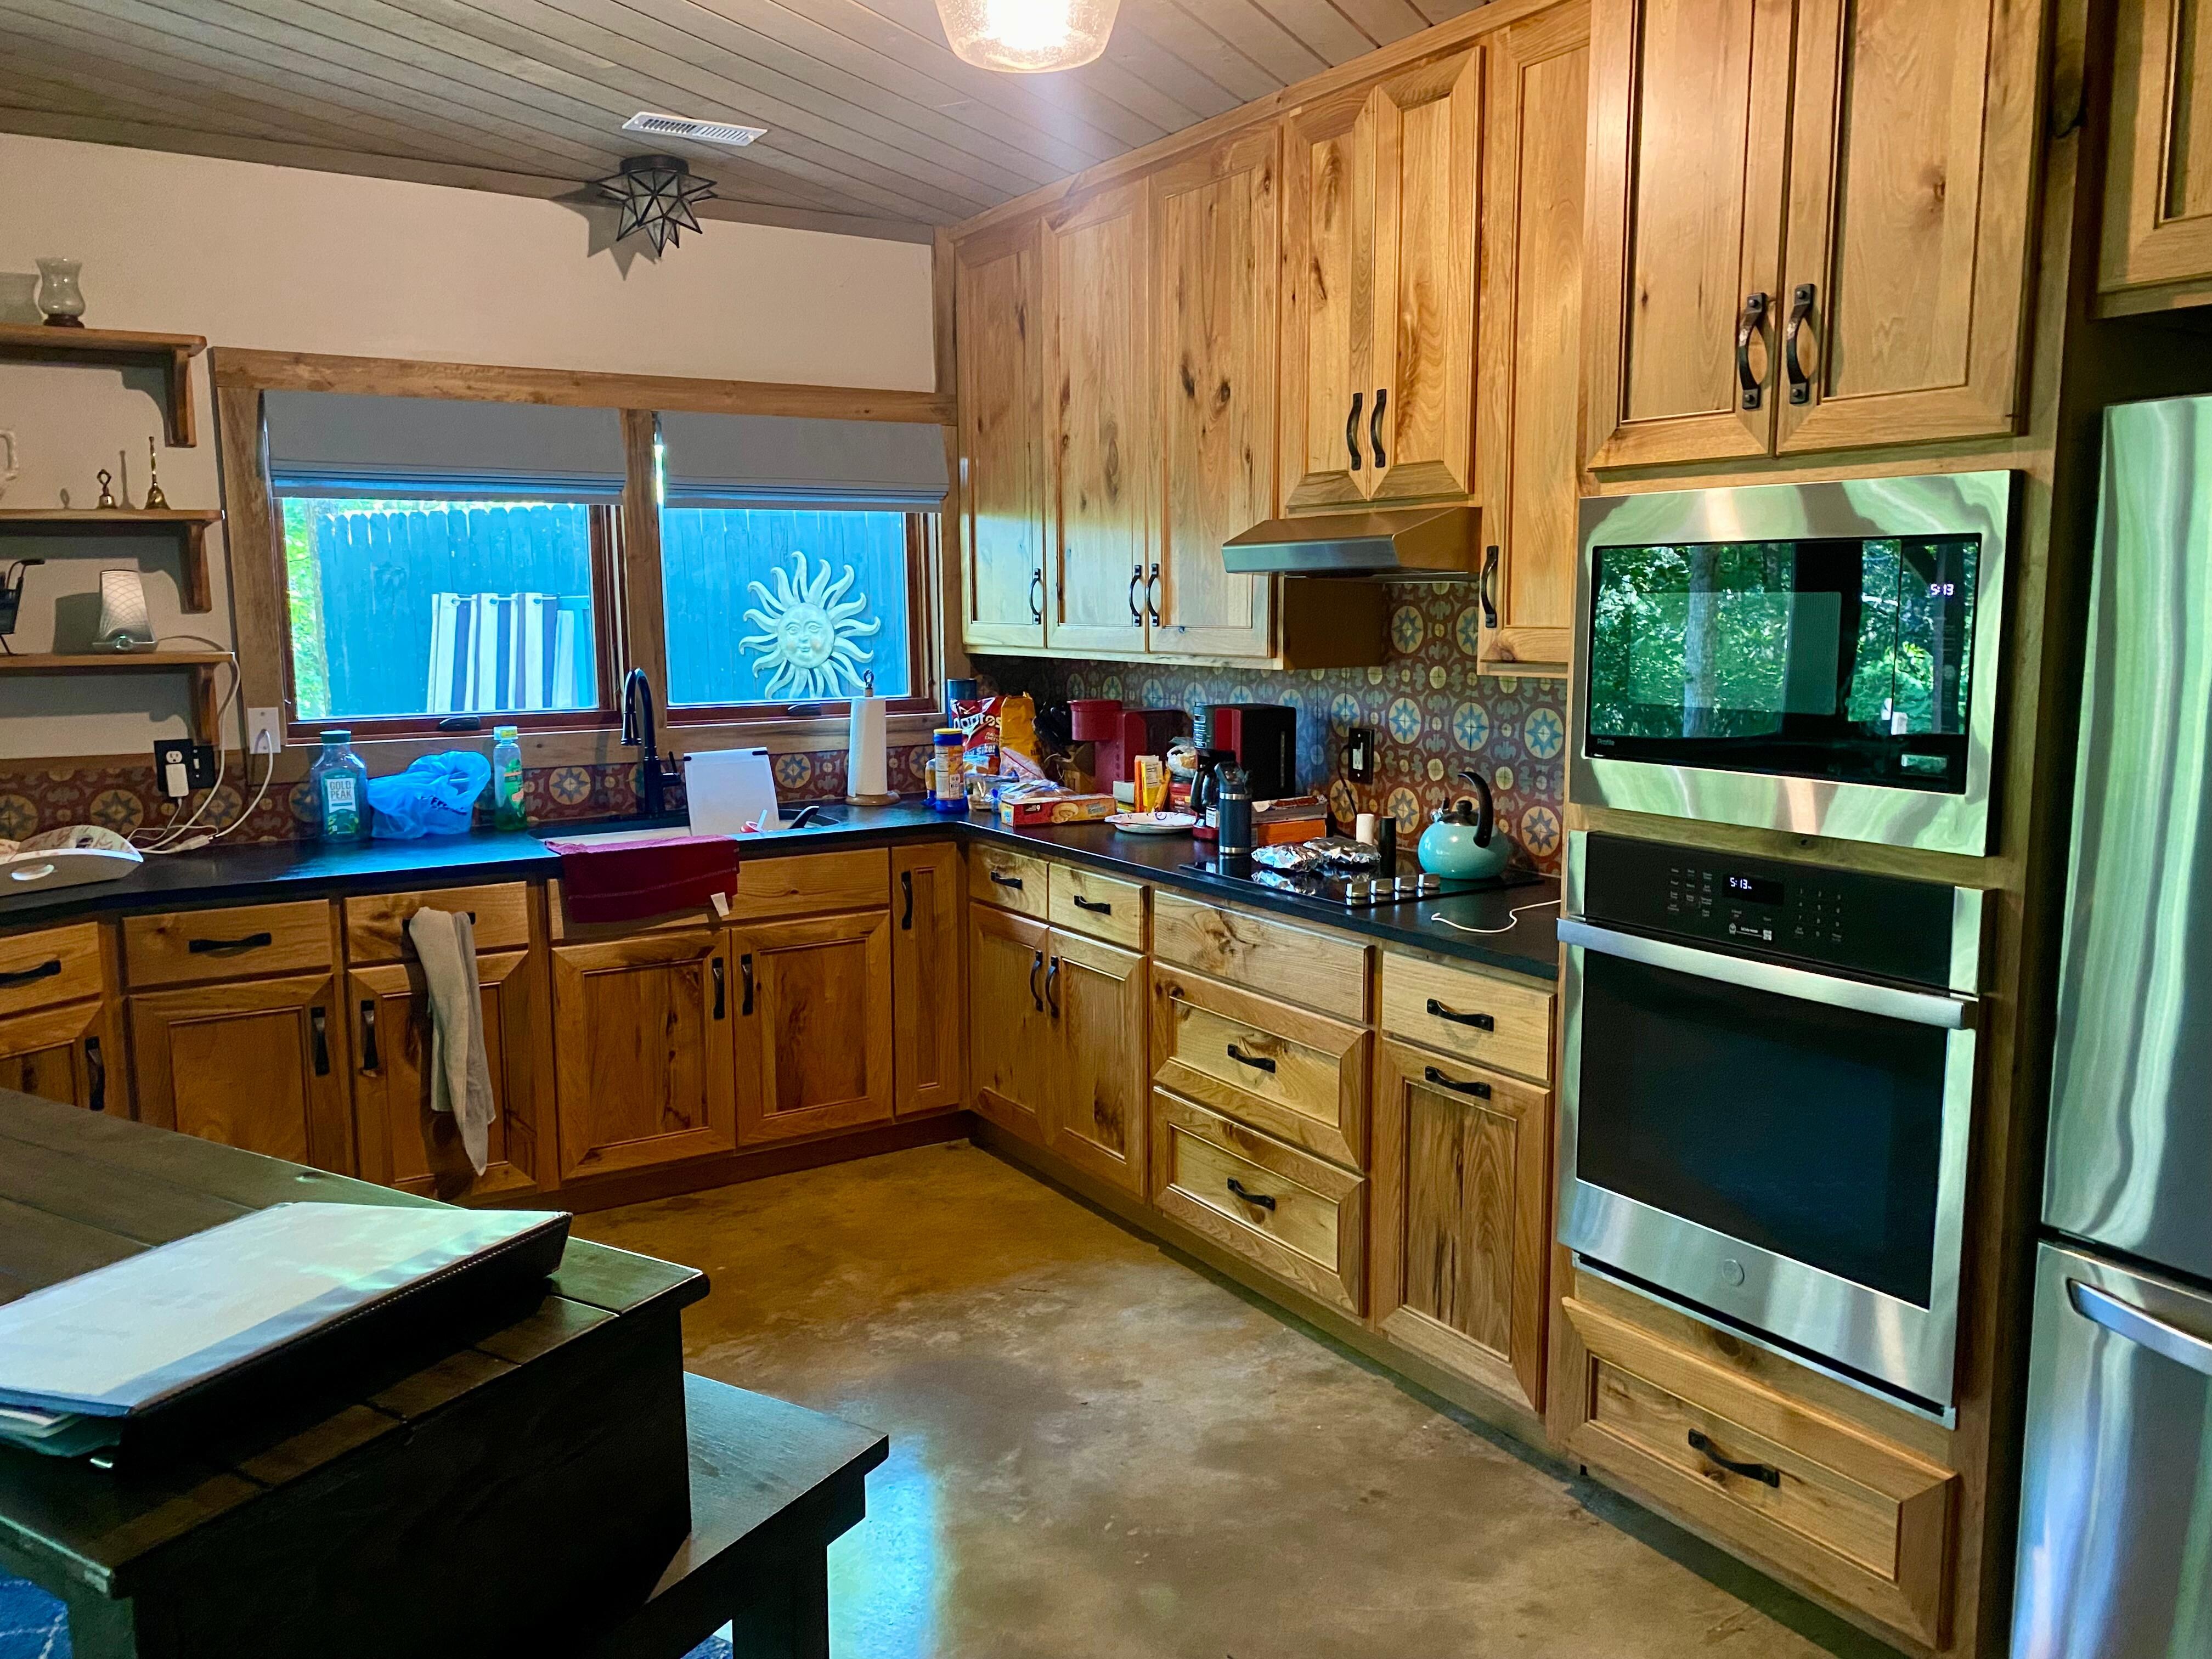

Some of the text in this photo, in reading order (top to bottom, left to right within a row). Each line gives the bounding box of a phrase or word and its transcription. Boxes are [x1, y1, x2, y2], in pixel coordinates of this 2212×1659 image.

[1930, 583, 1954, 596] 5:13
[330, 781, 352, 791] GOLD
[330, 789, 352, 799] PEAK
[1730, 877, 1748, 889] 5:13
